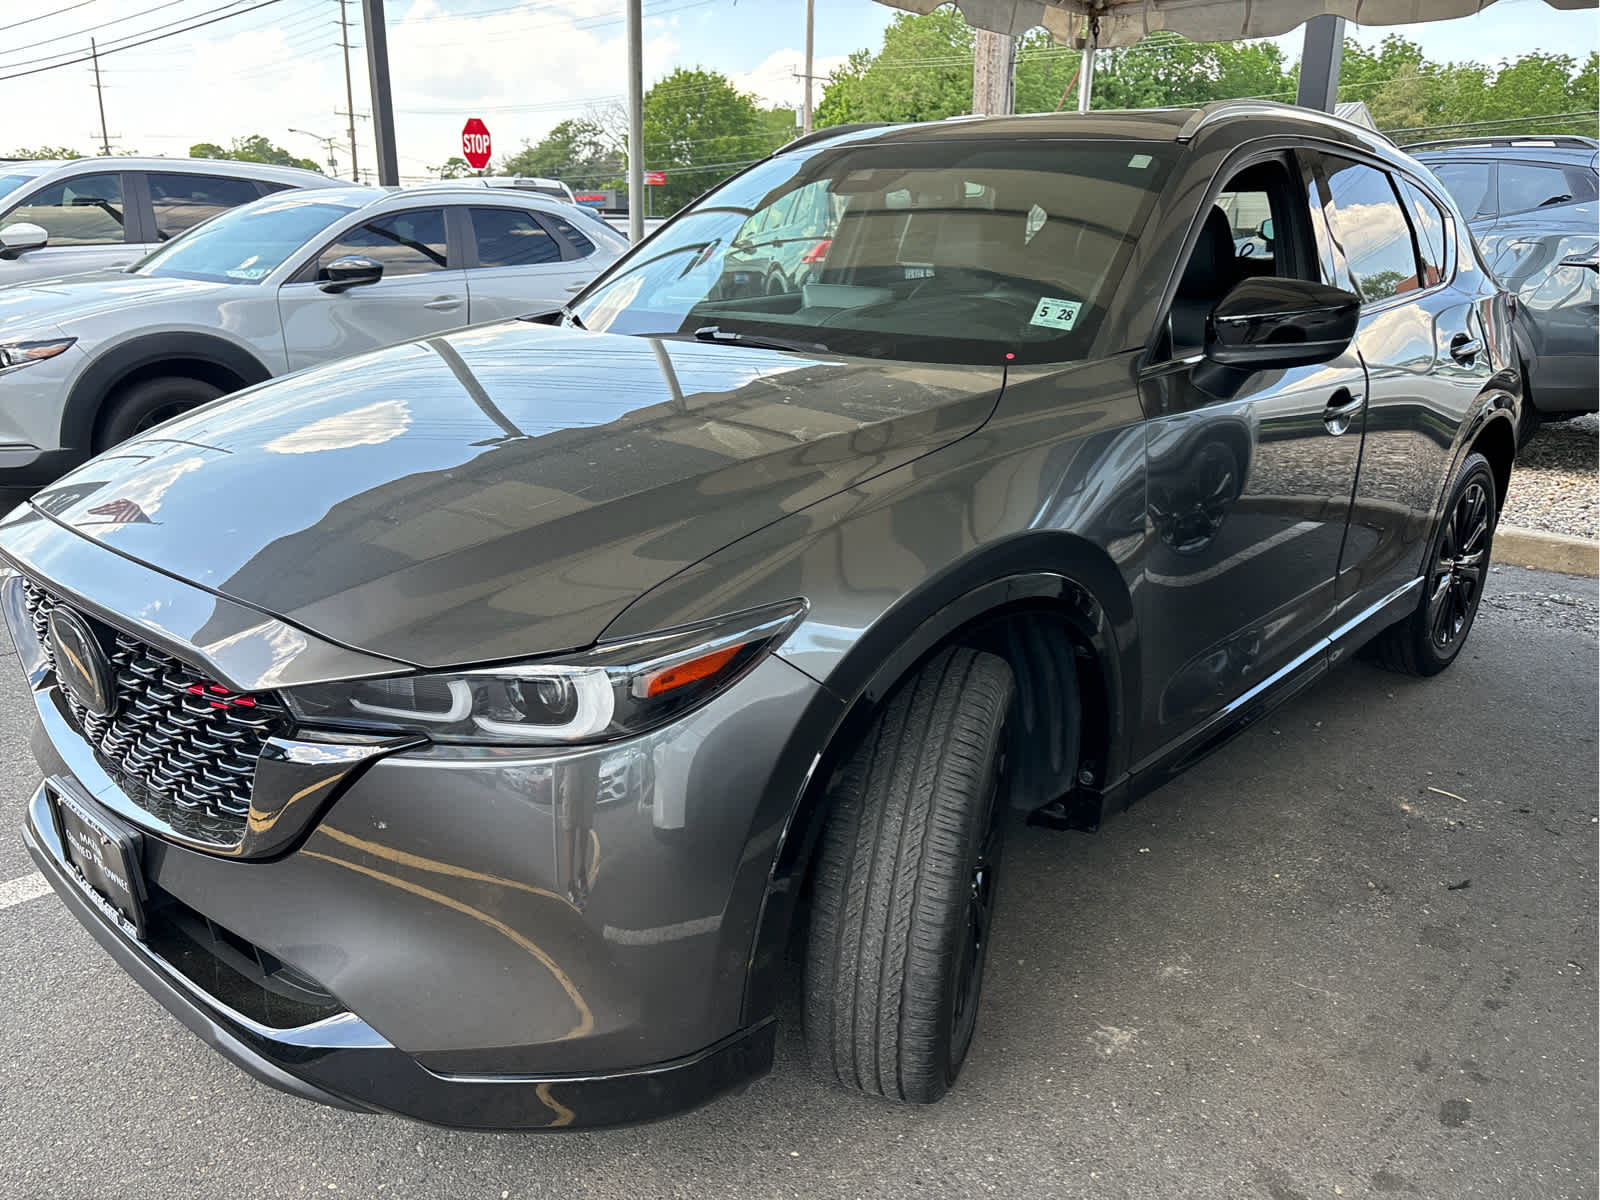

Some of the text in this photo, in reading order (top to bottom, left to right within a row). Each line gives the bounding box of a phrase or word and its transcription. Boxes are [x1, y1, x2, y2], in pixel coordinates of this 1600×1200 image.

[463, 134, 490, 154] STOP
[1040, 306, 1074, 321] 5 28
